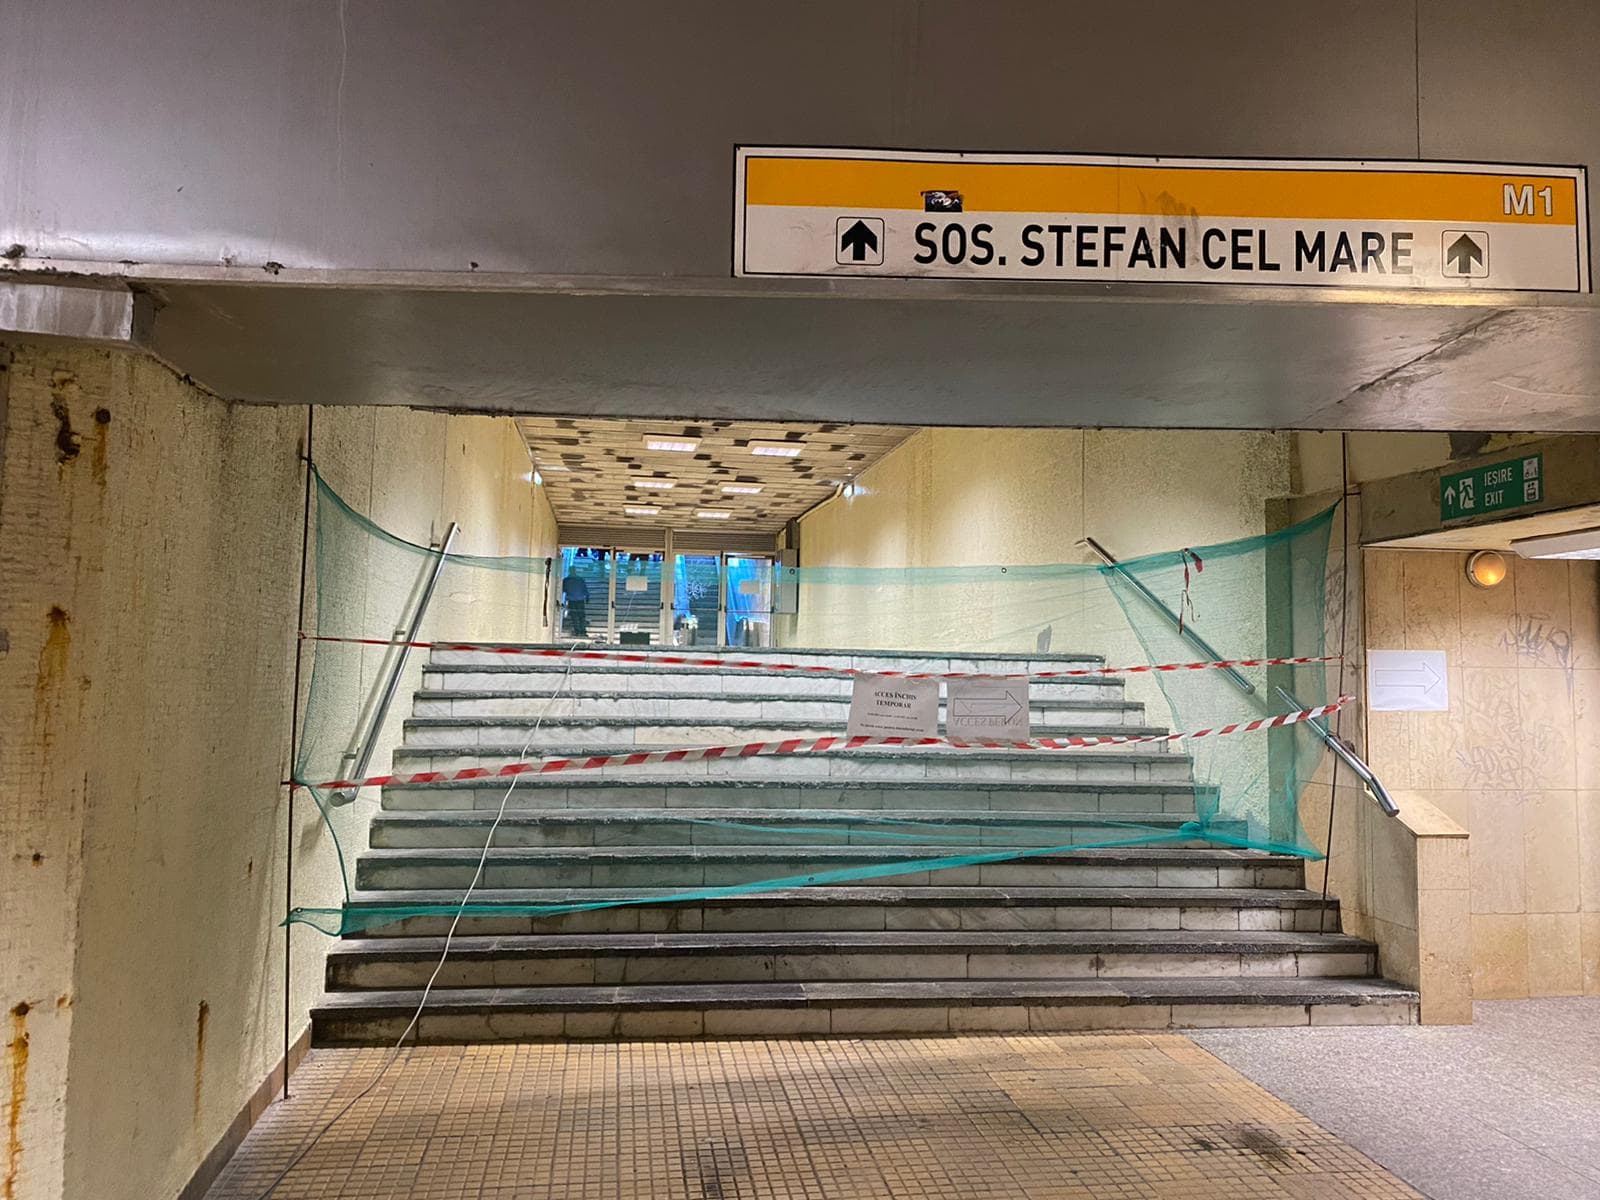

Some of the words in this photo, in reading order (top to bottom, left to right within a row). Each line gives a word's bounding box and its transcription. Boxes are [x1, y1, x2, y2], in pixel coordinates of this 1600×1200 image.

[1502, 183, 1553, 216] M1
[913, 222, 1007, 266] SOS.
[1020, 224, 1187, 269] STEFAN
[1202, 228, 1281, 272] CEL
[1295, 230, 1414, 275] MARE
[1484, 490, 1504, 507] EXIT
[874, 691, 894, 699] ACCES
[876, 699, 912, 709] TEMPORAR
